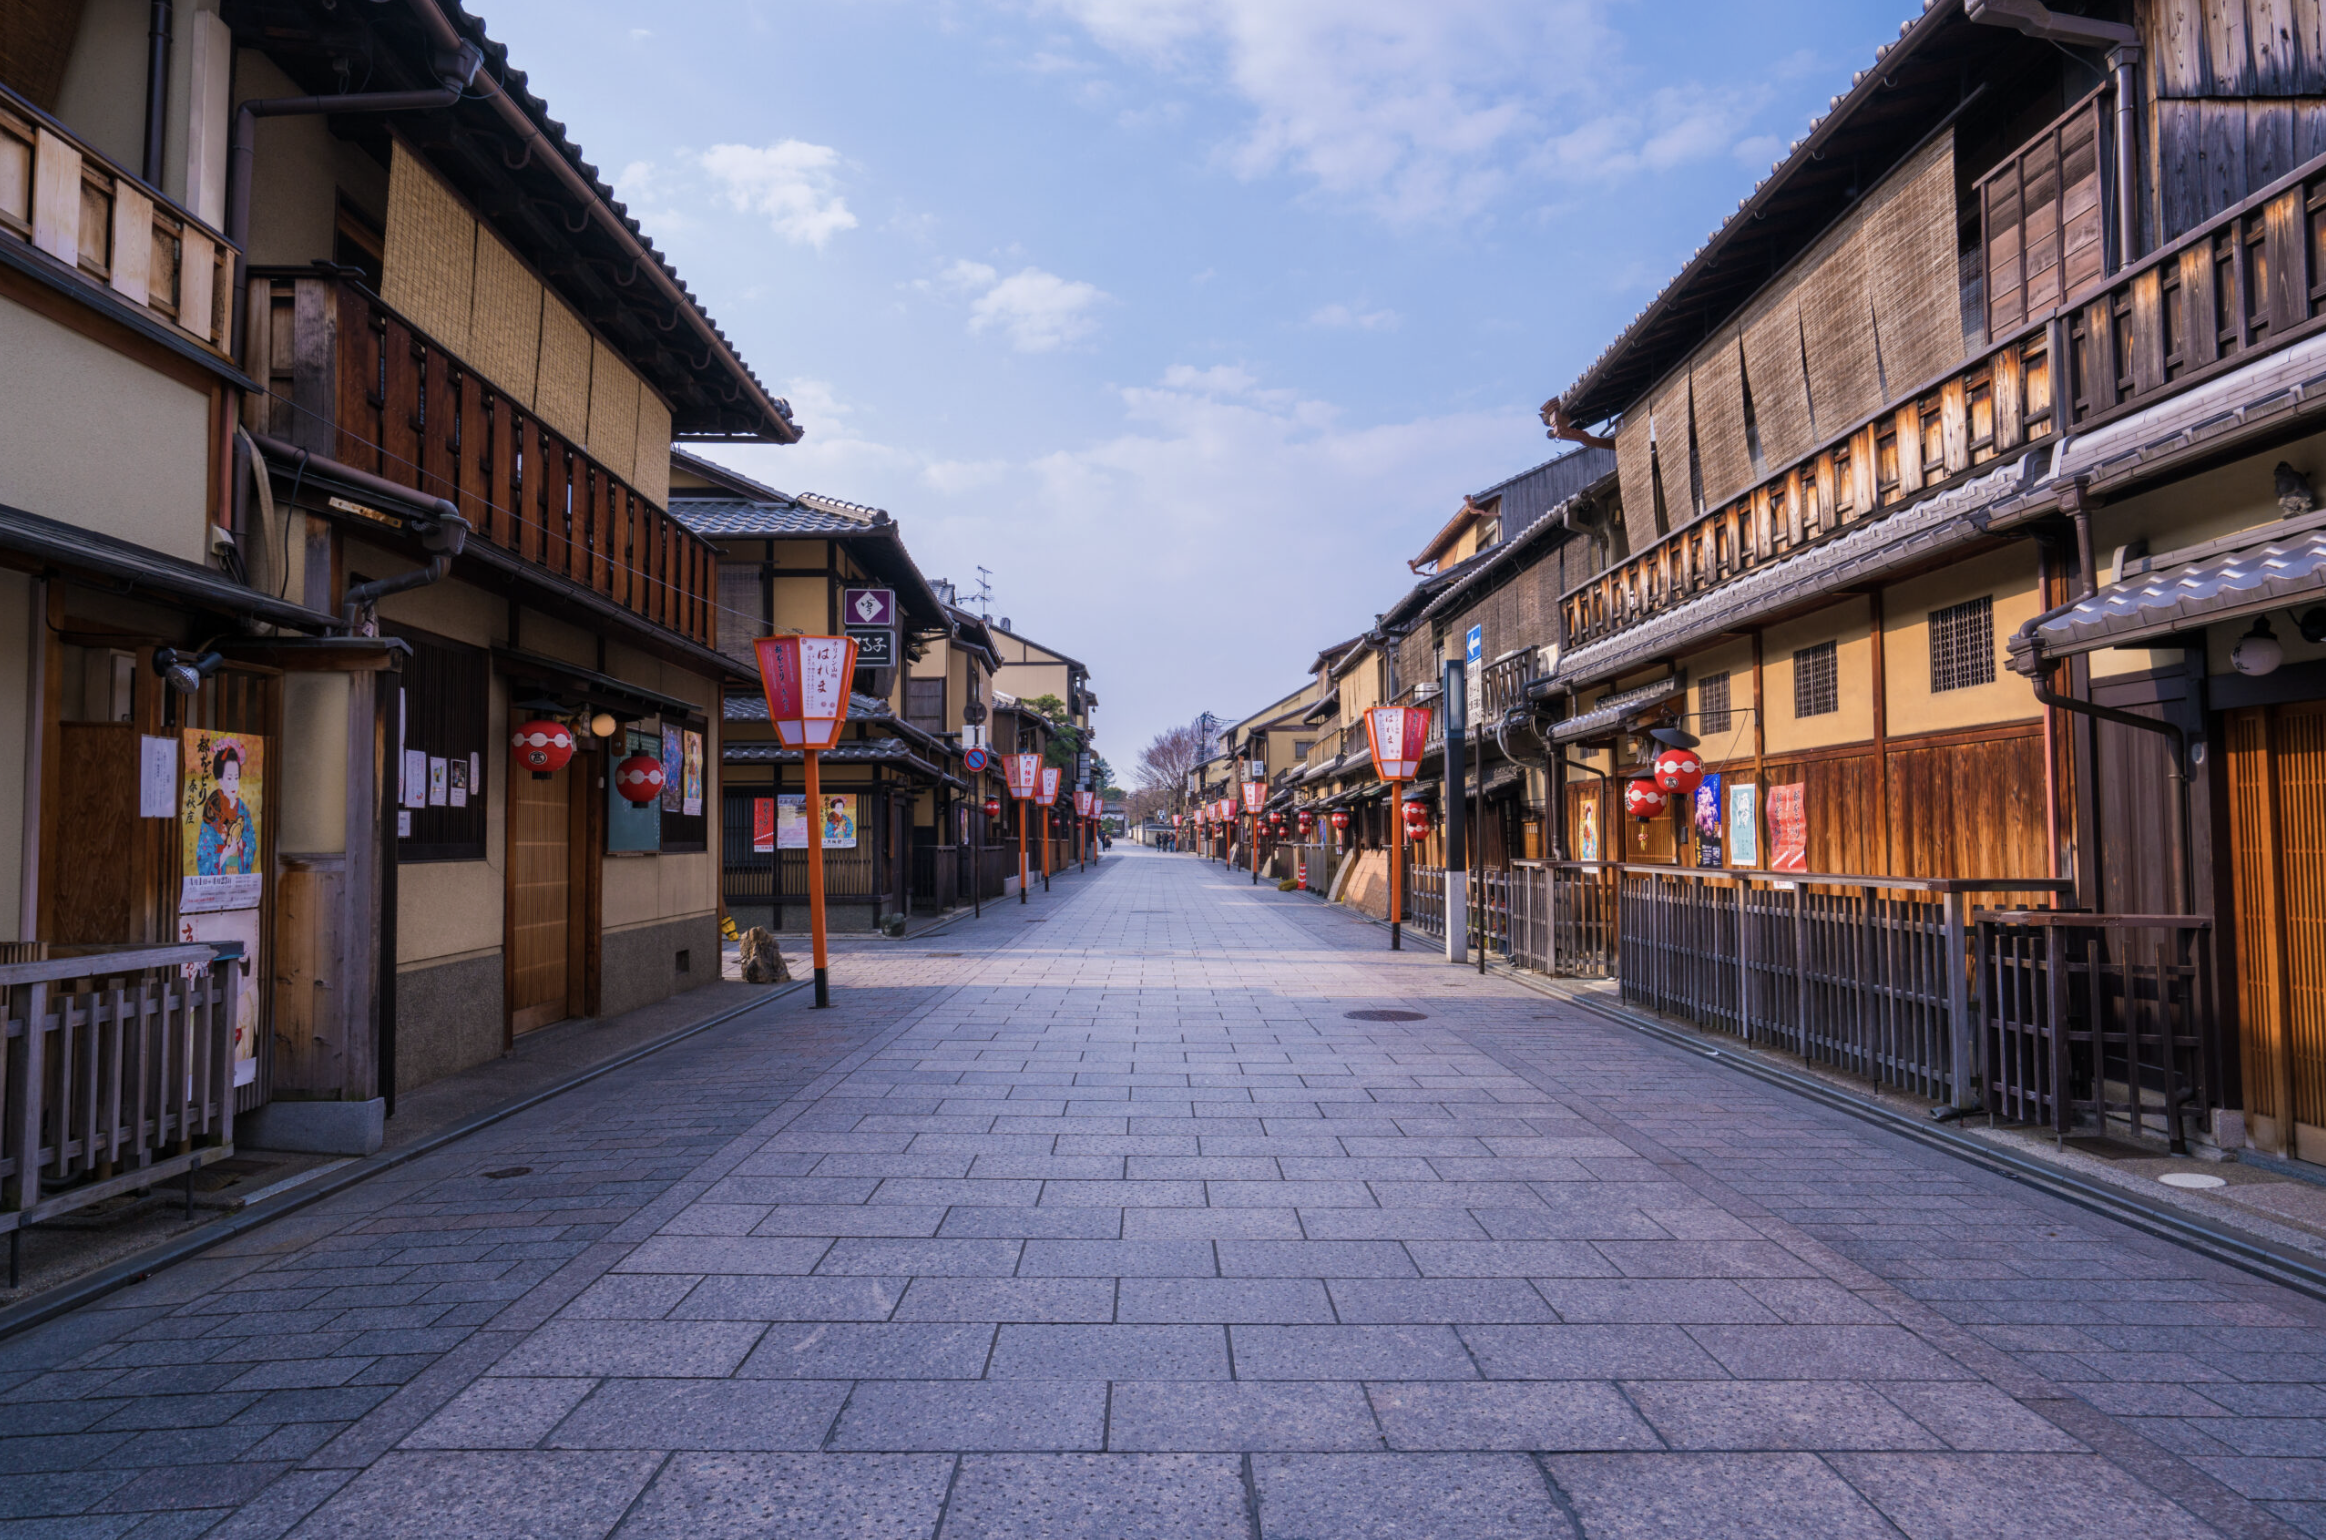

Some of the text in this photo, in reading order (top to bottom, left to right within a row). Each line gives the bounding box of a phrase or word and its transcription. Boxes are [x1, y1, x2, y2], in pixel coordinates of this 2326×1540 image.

[817, 648, 829, 693] はれま
[197, 734, 211, 806] 都をどり
[185, 779, 198, 824] 春秋座
